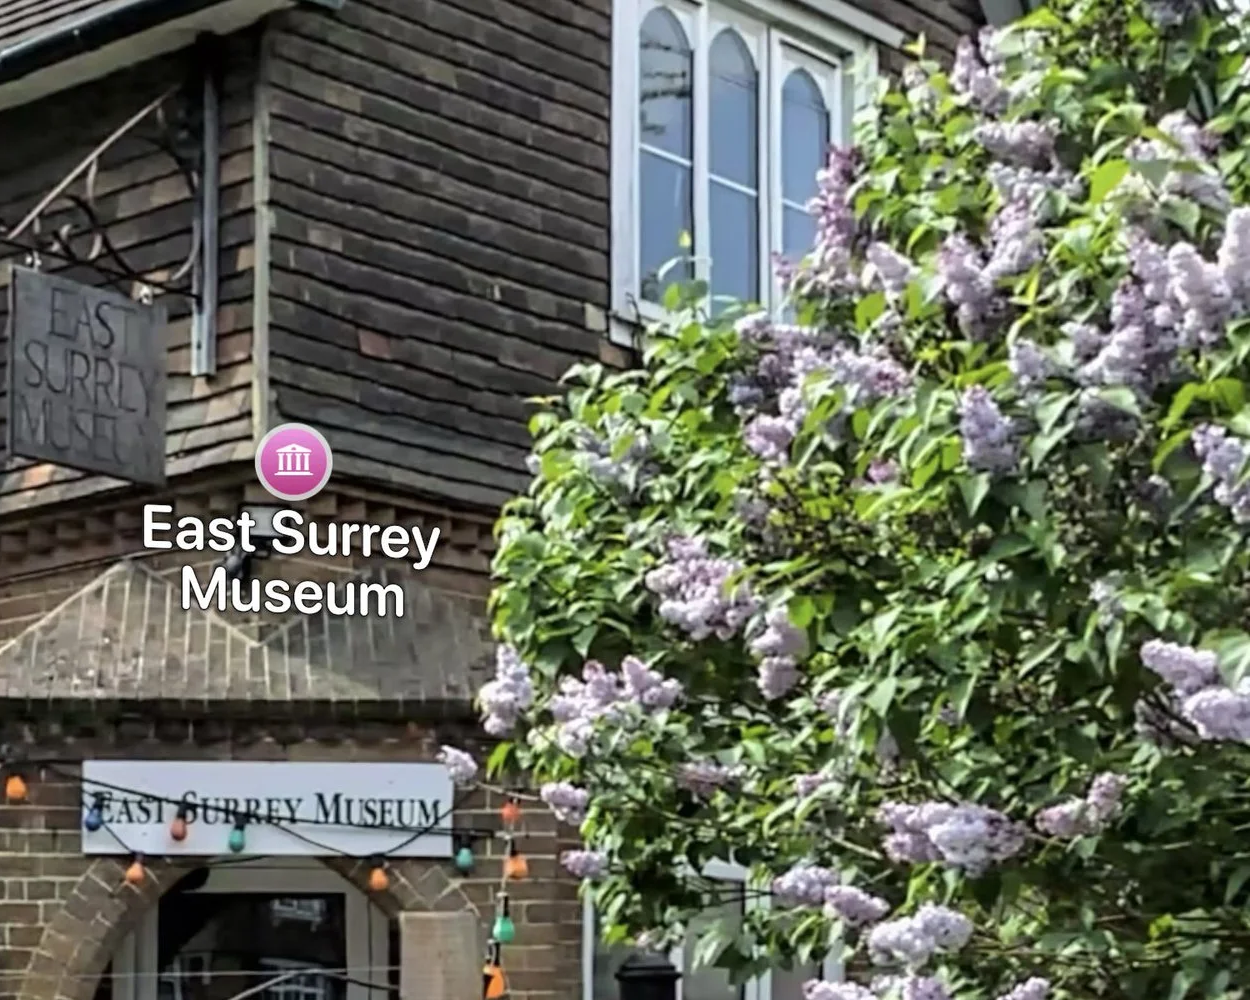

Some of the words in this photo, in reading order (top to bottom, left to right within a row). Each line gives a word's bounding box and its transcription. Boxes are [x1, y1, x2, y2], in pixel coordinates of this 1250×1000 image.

[49, 286, 138, 355] EAST
[97, 790, 166, 824] EAST
[177, 790, 302, 826] SURREY
[315, 792, 441, 828] MUSEUM
